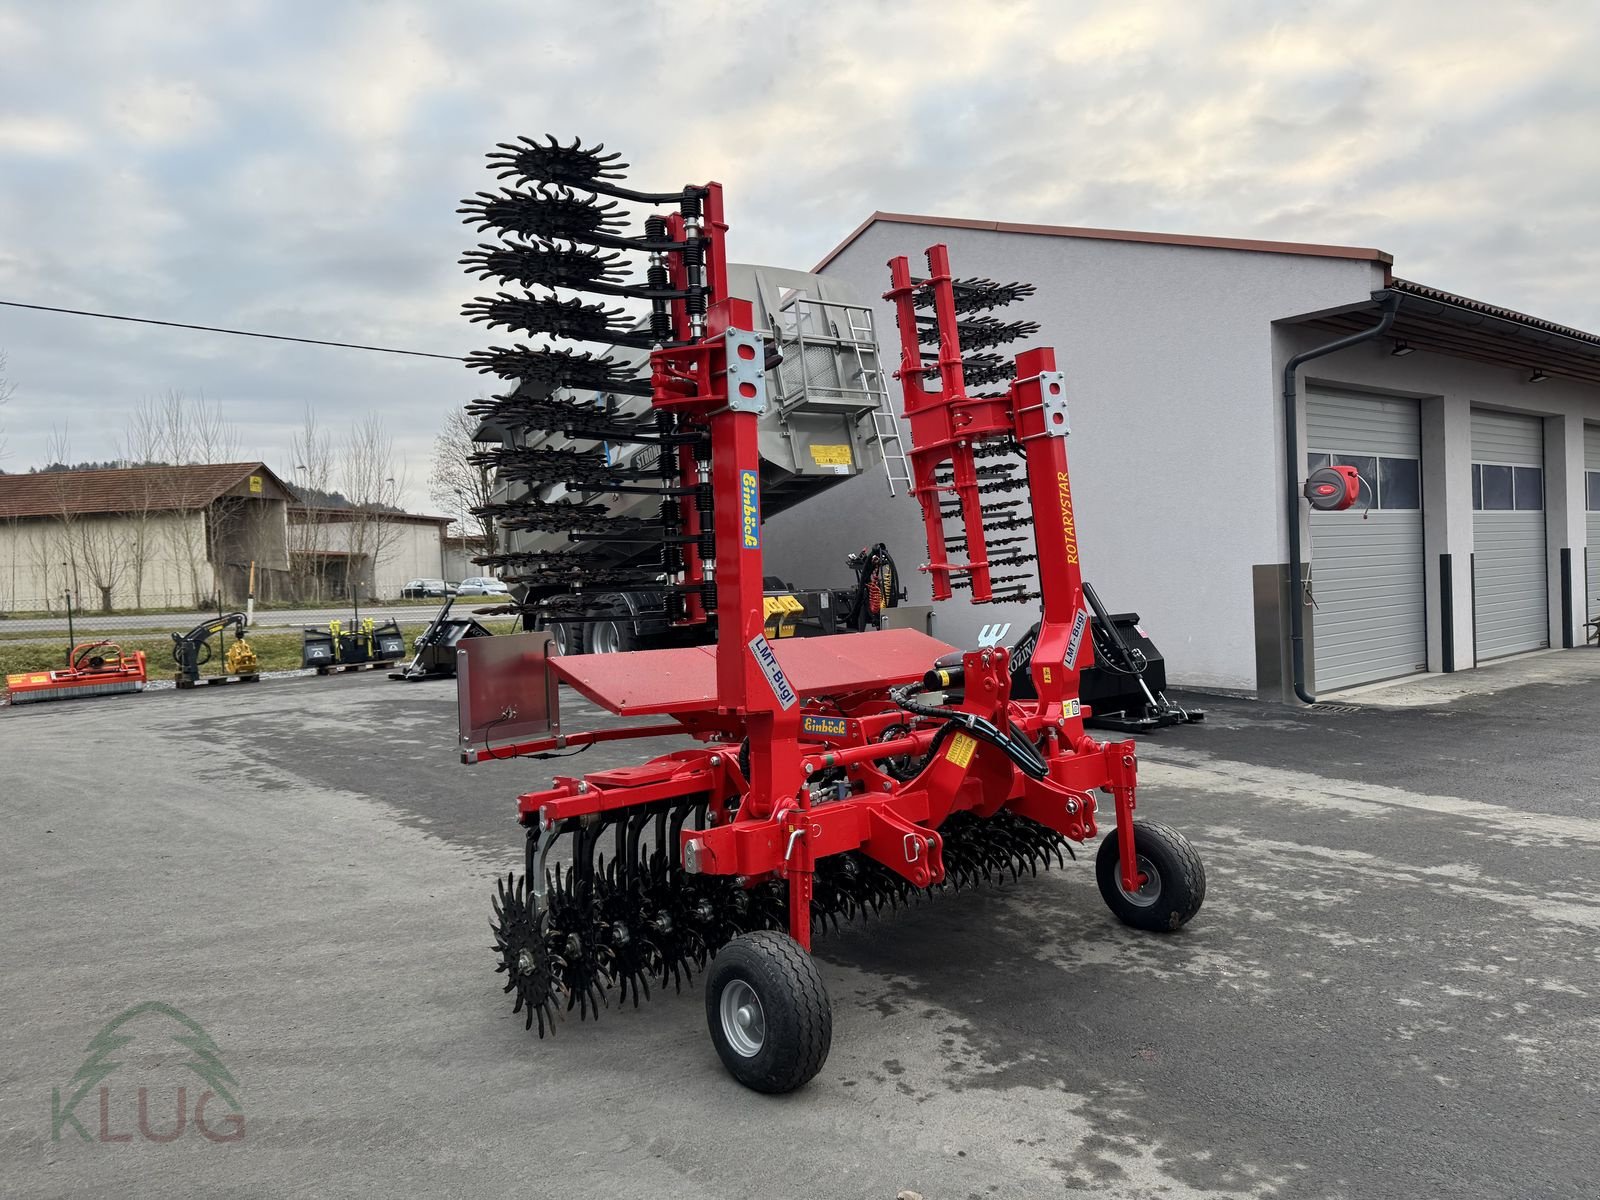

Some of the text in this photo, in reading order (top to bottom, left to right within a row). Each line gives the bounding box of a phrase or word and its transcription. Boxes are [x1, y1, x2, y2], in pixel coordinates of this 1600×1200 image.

[743, 472, 758, 547] Einböck
[1057, 471, 1078, 564] ROTARYSTAR
[755, 638, 794, 703] LMT-Bugl
[1064, 611, 1085, 665] LMT-Bugl
[804, 717, 845, 735] Einböck
